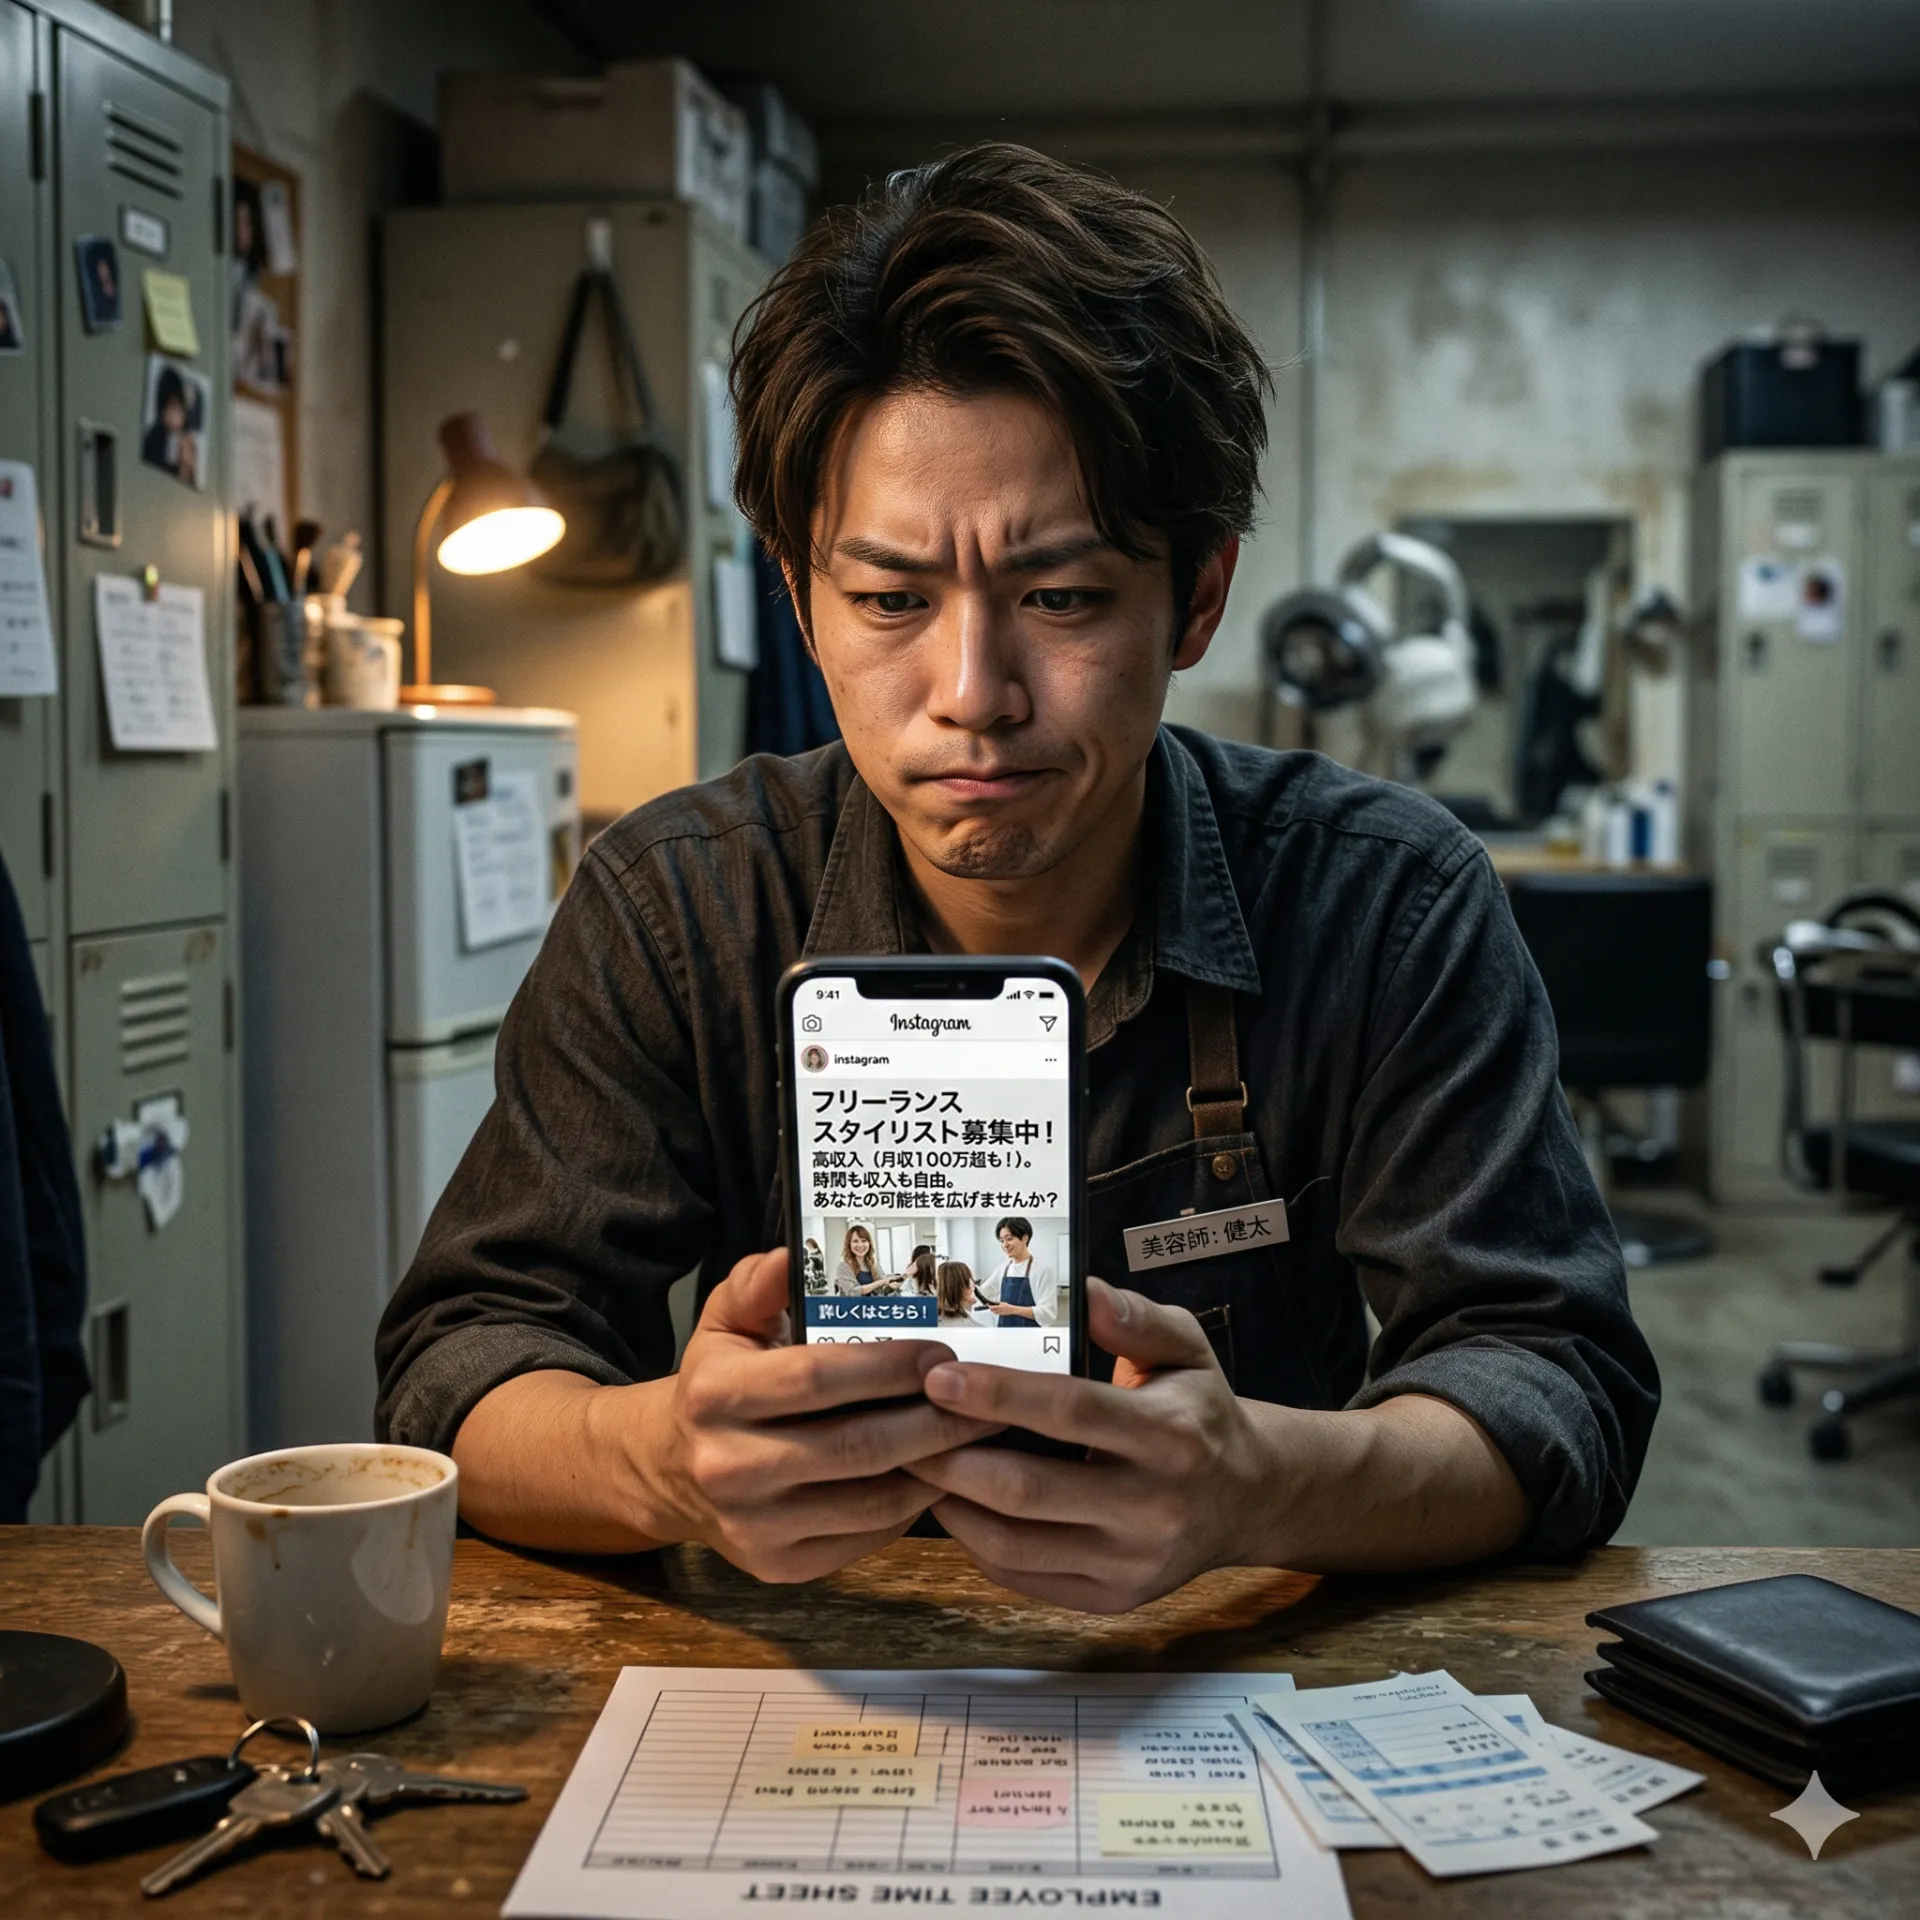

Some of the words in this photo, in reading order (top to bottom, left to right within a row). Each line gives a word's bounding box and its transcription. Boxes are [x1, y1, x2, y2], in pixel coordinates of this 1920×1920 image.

[816, 990, 840, 1000] 9:41
[890, 1013, 971, 1037] Instagram
[834, 1055, 889, 1066] instagram
[812, 1090, 963, 1114] フリーランス
[813, 1171, 954, 1189] 時間も収入も自由。
[813, 1191, 1058, 1209] あなたの可能性を広げませんか？
[740, 1884, 860, 1902] SHEET
[872, 1886, 955, 1904] TIME
[970, 1889, 1162, 1908] EMPLOYEE
